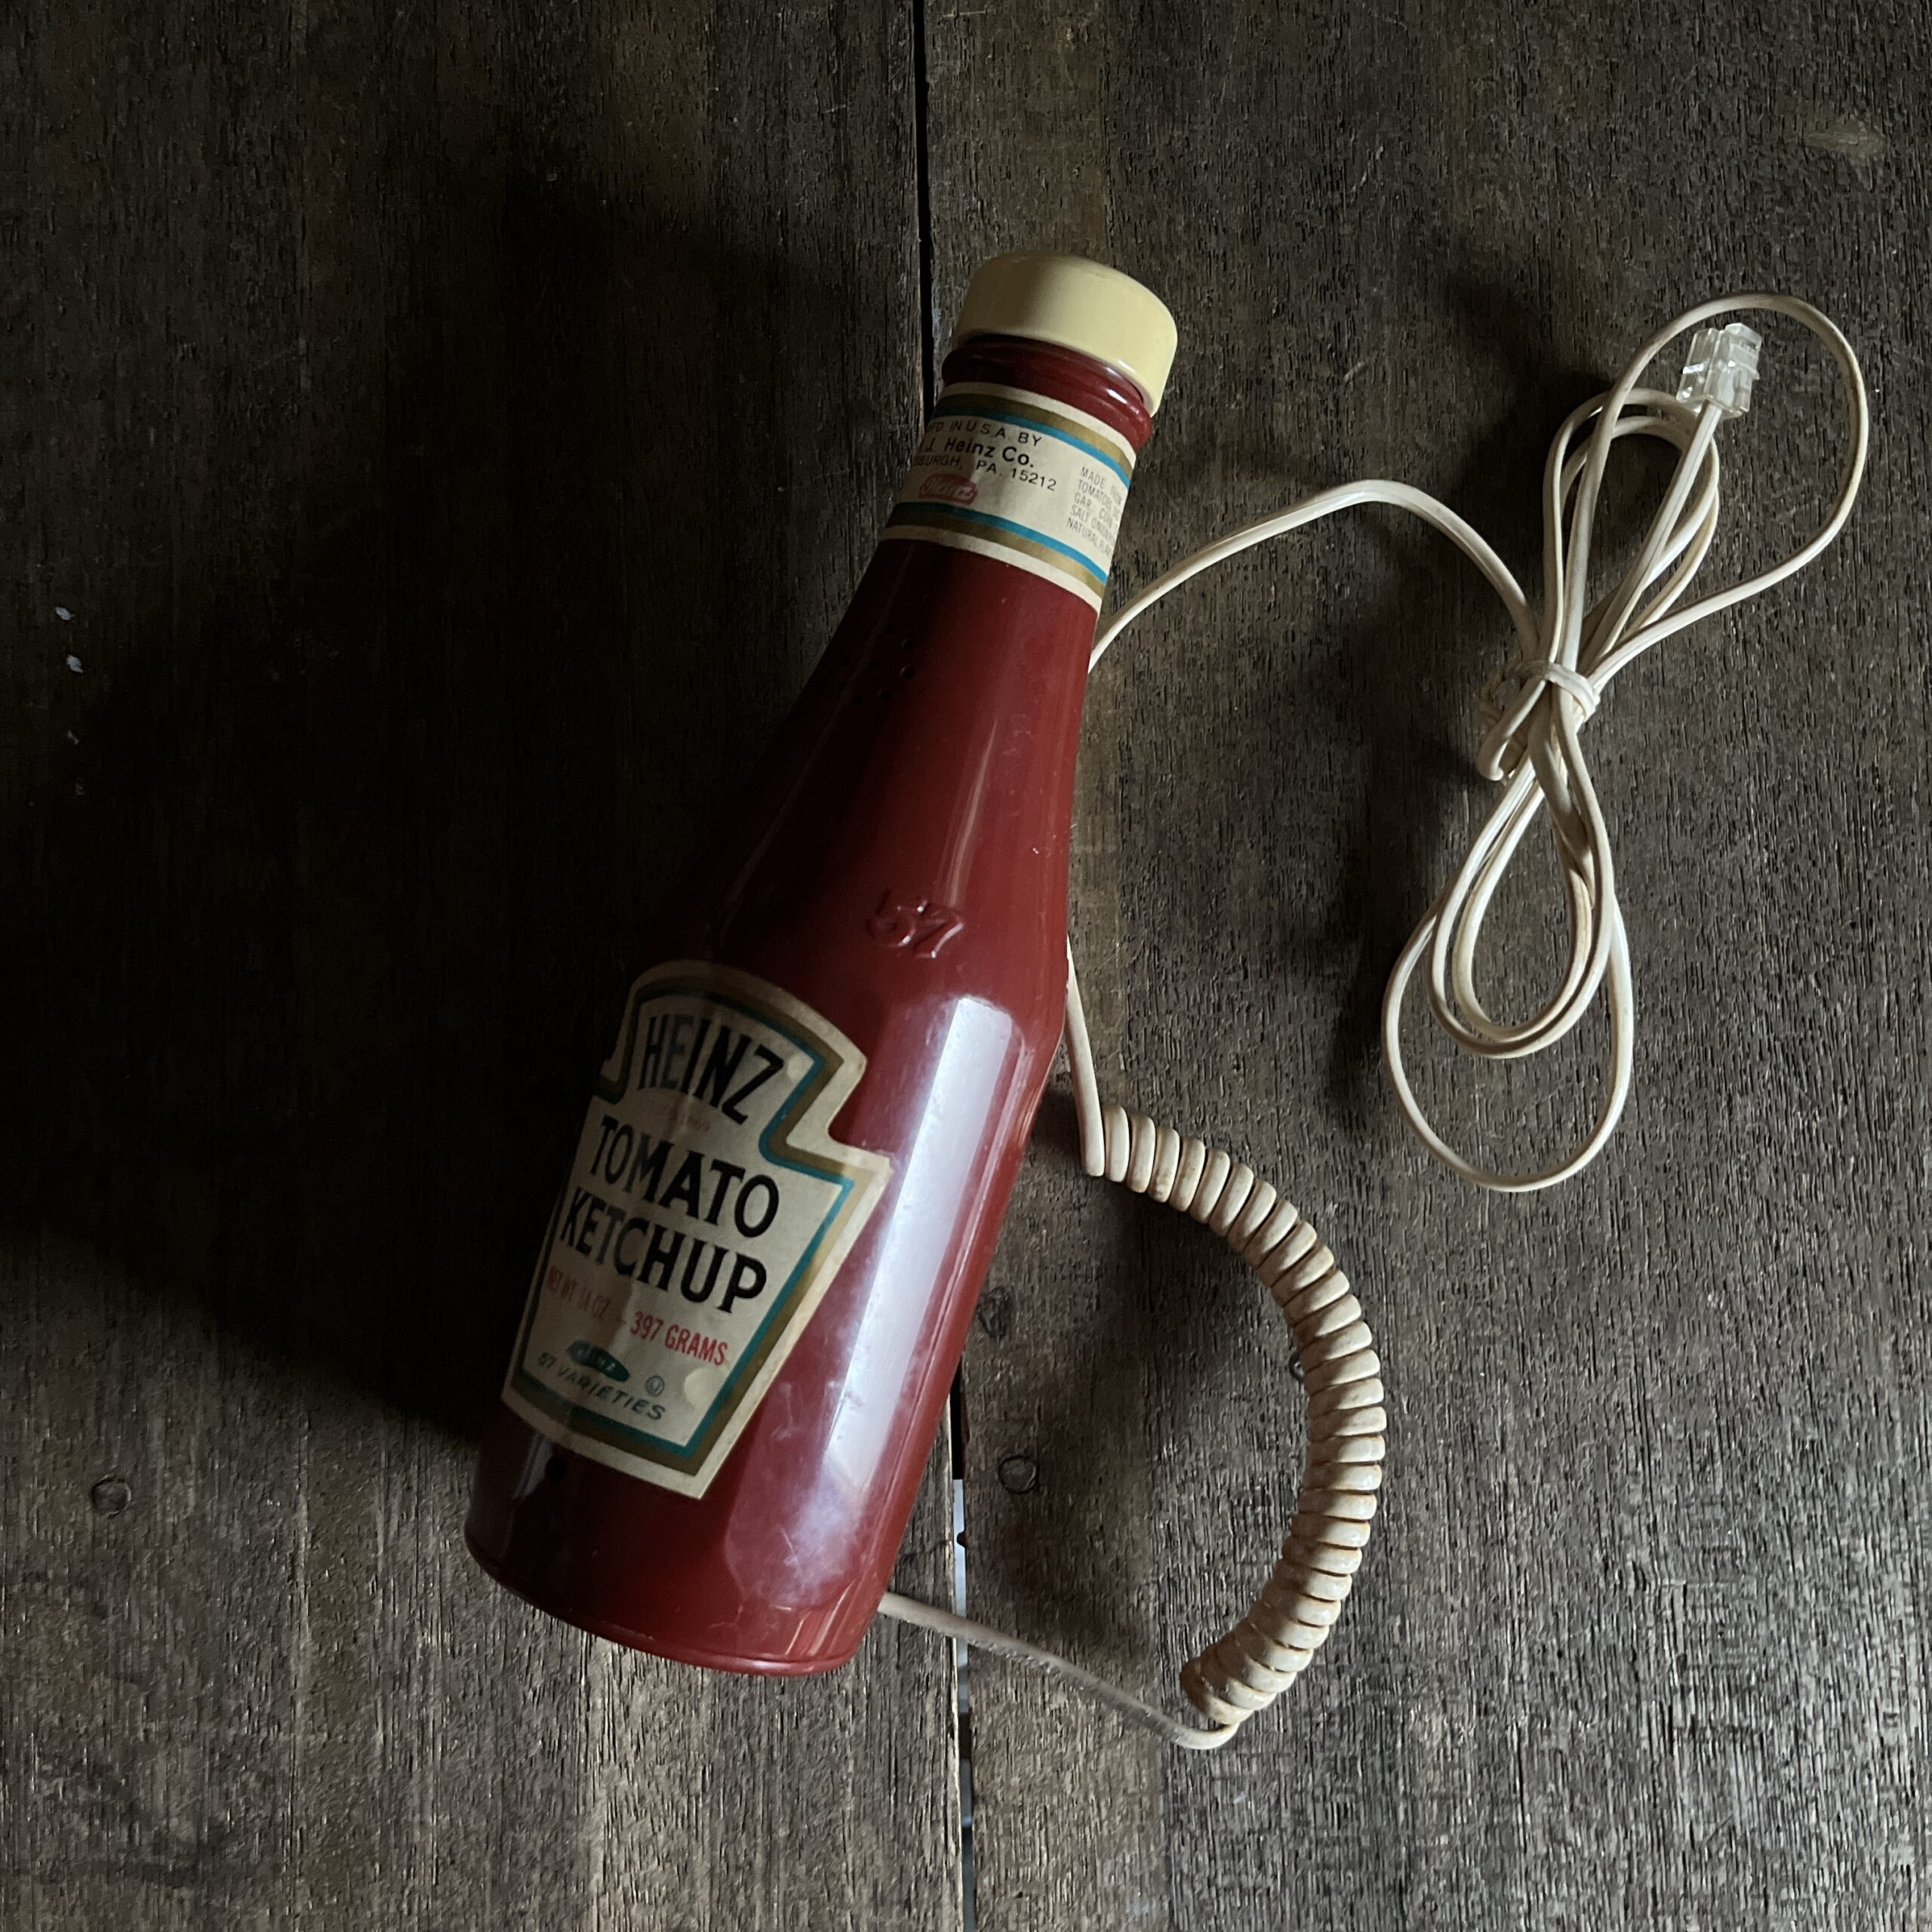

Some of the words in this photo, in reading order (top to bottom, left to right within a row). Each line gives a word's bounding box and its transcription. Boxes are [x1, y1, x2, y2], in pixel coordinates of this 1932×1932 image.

[943, 435, 995, 459] Heinz
[1001, 446, 1034, 468] Co.
[1018, 432, 1042, 447] BY
[1011, 468, 1057, 492] 15212
[1081, 466, 1106, 490] MADE
[865, 889, 964, 958] 57
[637, 1014, 783, 1124] HEINZ
[590, 1115, 779, 1238] TOMATO
[559, 1186, 767, 1313] KETCHUP
[630, 1311, 664, 1341] 397
[664, 1324, 728, 1366] GRAMS
[558, 1366, 666, 1420] VARIETIES
